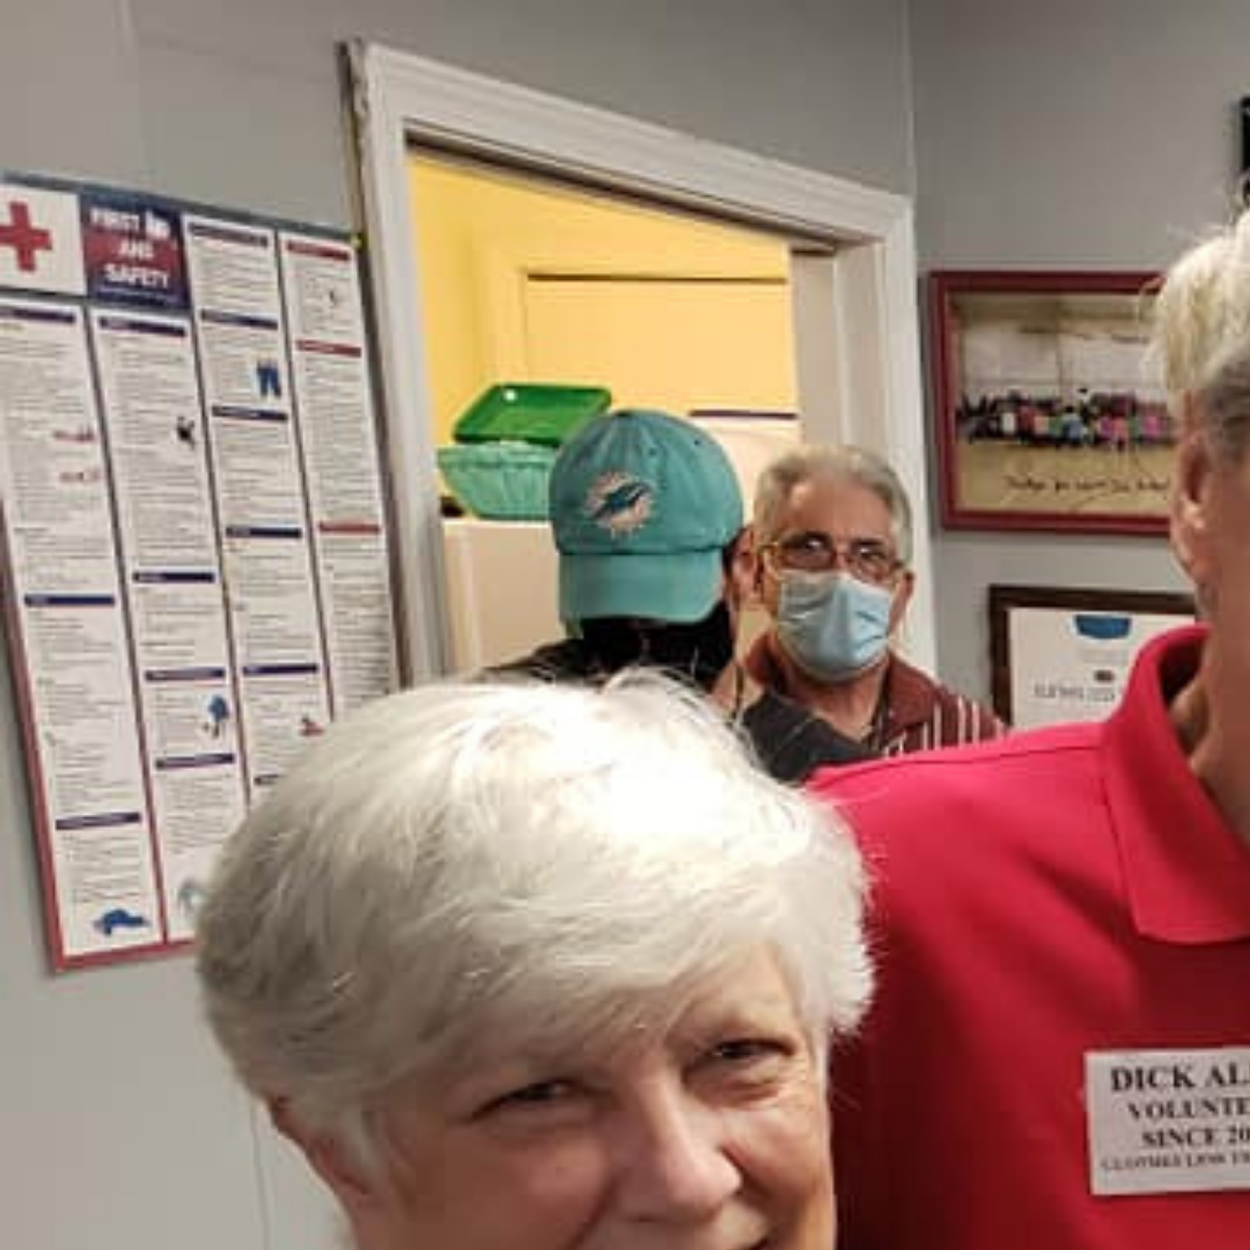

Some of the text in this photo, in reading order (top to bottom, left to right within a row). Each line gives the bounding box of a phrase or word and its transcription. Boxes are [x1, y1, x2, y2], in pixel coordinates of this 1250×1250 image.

[103, 263, 169, 288] SAFETY
[1110, 1064, 1197, 1092] DICK
[1142, 1127, 1223, 1149] SINCE
